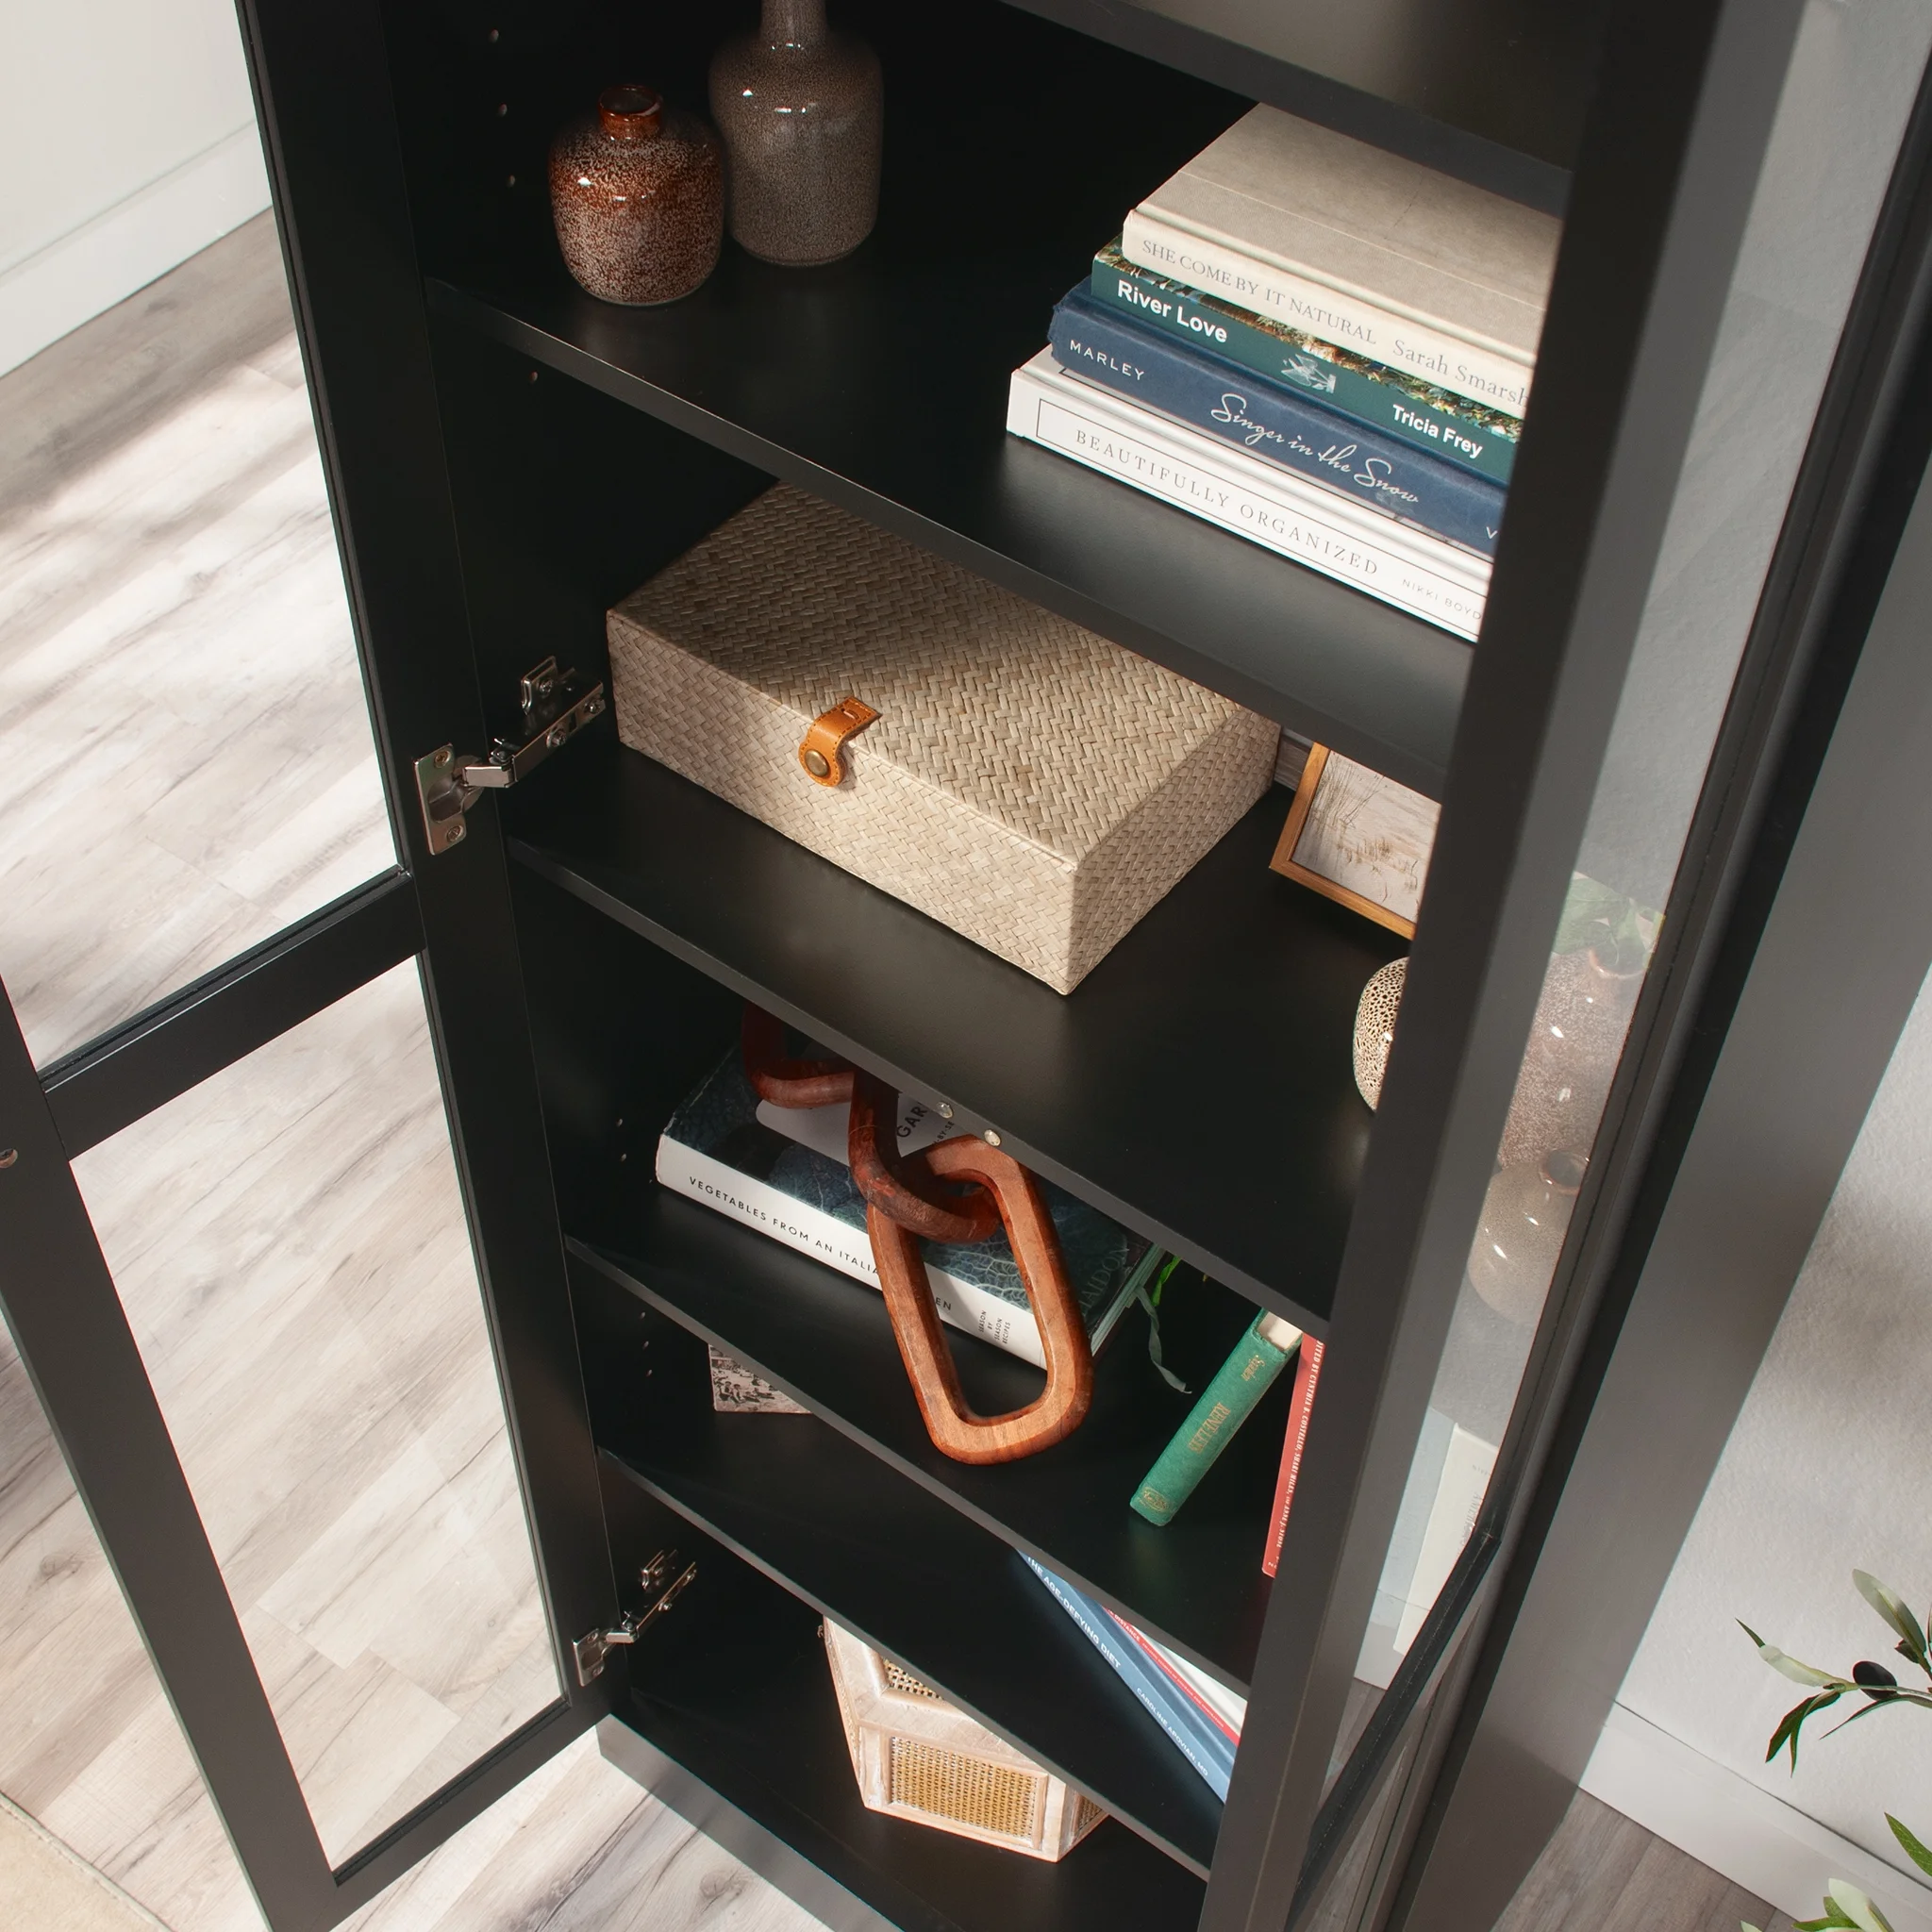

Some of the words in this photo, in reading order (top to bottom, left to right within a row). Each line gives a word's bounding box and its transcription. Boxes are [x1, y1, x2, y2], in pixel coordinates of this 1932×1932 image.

[1117, 279, 1172, 318] River
[1176, 306, 1227, 343] Love
[1141, 240, 1176, 264] SHE
[1179, 255, 1232, 286] COME
[1236, 276, 1259, 295] BY
[1265, 289, 1286, 306] IT
[1289, 297, 1378, 345] NATURAL
[1069, 339, 1145, 381] MARLEY
[1392, 339, 1448, 375] Sarah
[1210, 392, 1285, 446] Singer
[1288, 436, 1314, 457] in
[1317, 444, 1358, 474] the
[1353, 458, 1419, 503] Snow
[1391, 404, 1440, 440] Tricia
[1442, 426, 1484, 460] Frey
[1076, 429, 1230, 508] BEAUTIFULLY
[1240, 504, 1379, 575] ORGANIZED
[1402, 578, 1440, 601] NIKKI
[1444, 597, 1482, 621] BOYD
[897, 1102, 928, 1138] GAR
[689, 1175, 767, 1221] VEGETABLES
[773, 1217, 809, 1242] FROM
[815, 1240, 833, 1254] AN
[839, 1250, 879, 1274] ITALIA
[977, 1309, 987, 1333] SEASON
[993, 1317, 1003, 1341] SEASON
[1002, 1322, 1011, 1344] RECIPES
[1311, 1363, 1320, 1374] BY
[1305, 1375, 1317, 1406] CYNTHIA
[1294, 1415, 1308, 1451] COSTELLO,
[1291, 1453, 1301, 1473] SHARI
[1043, 1576, 1100, 1644] AGE-DEFYING
[1101, 1642, 1122, 1668] DIET
[1137, 1688, 1168, 1727] CAROLINE
[1197, 1761, 1208, 1776] MD
